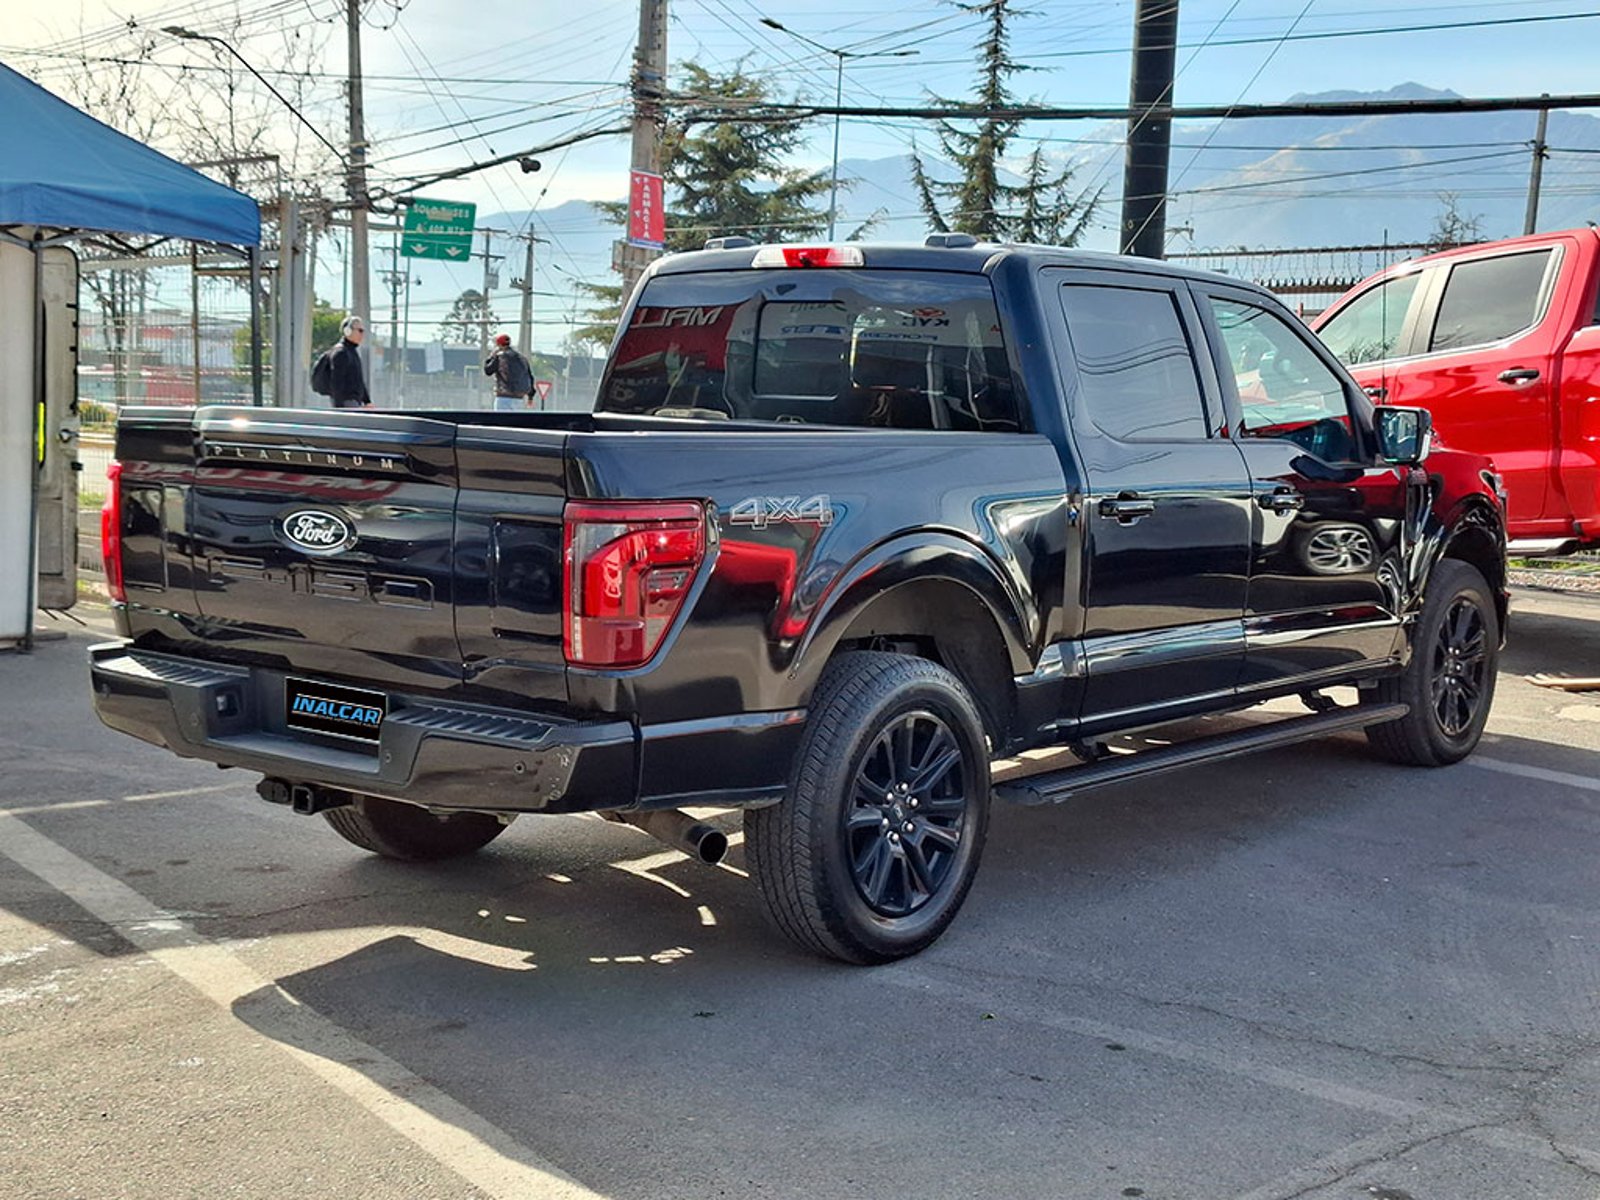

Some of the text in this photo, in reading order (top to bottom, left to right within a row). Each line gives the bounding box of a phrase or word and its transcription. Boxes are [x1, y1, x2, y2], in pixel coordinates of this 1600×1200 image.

[642, 176, 652, 239] FARMACIA
[214, 446, 394, 470] PLATINUM
[293, 514, 336, 544] Ford
[293, 695, 379, 725] INALCAR
